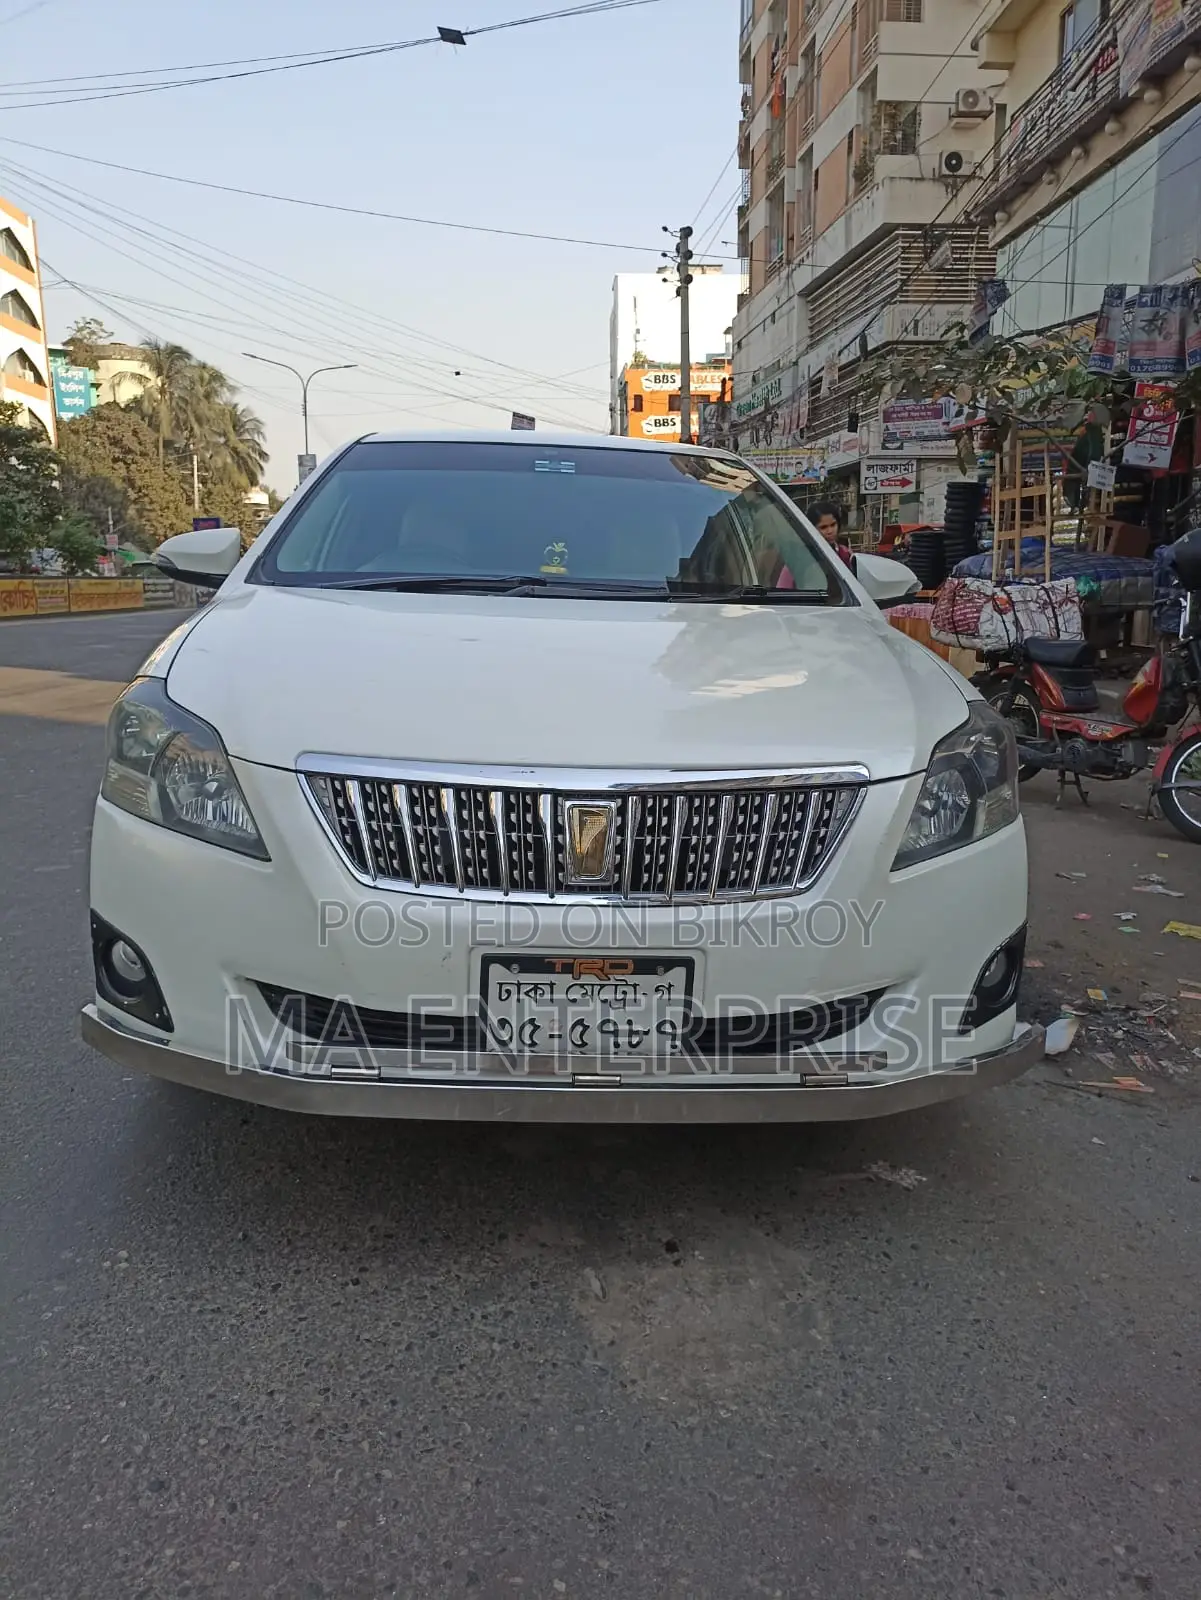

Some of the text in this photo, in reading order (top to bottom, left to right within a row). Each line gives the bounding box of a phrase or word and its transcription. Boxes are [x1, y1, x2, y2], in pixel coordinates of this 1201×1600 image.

[654, 375, 676, 384] BBS
[654, 418, 676, 427] BBS
[545, 958, 634, 980] TRD
[496, 980, 556, 1004] ঢাকা
[489, 1017, 678, 1049] ৩৫-৫৭৮৭
